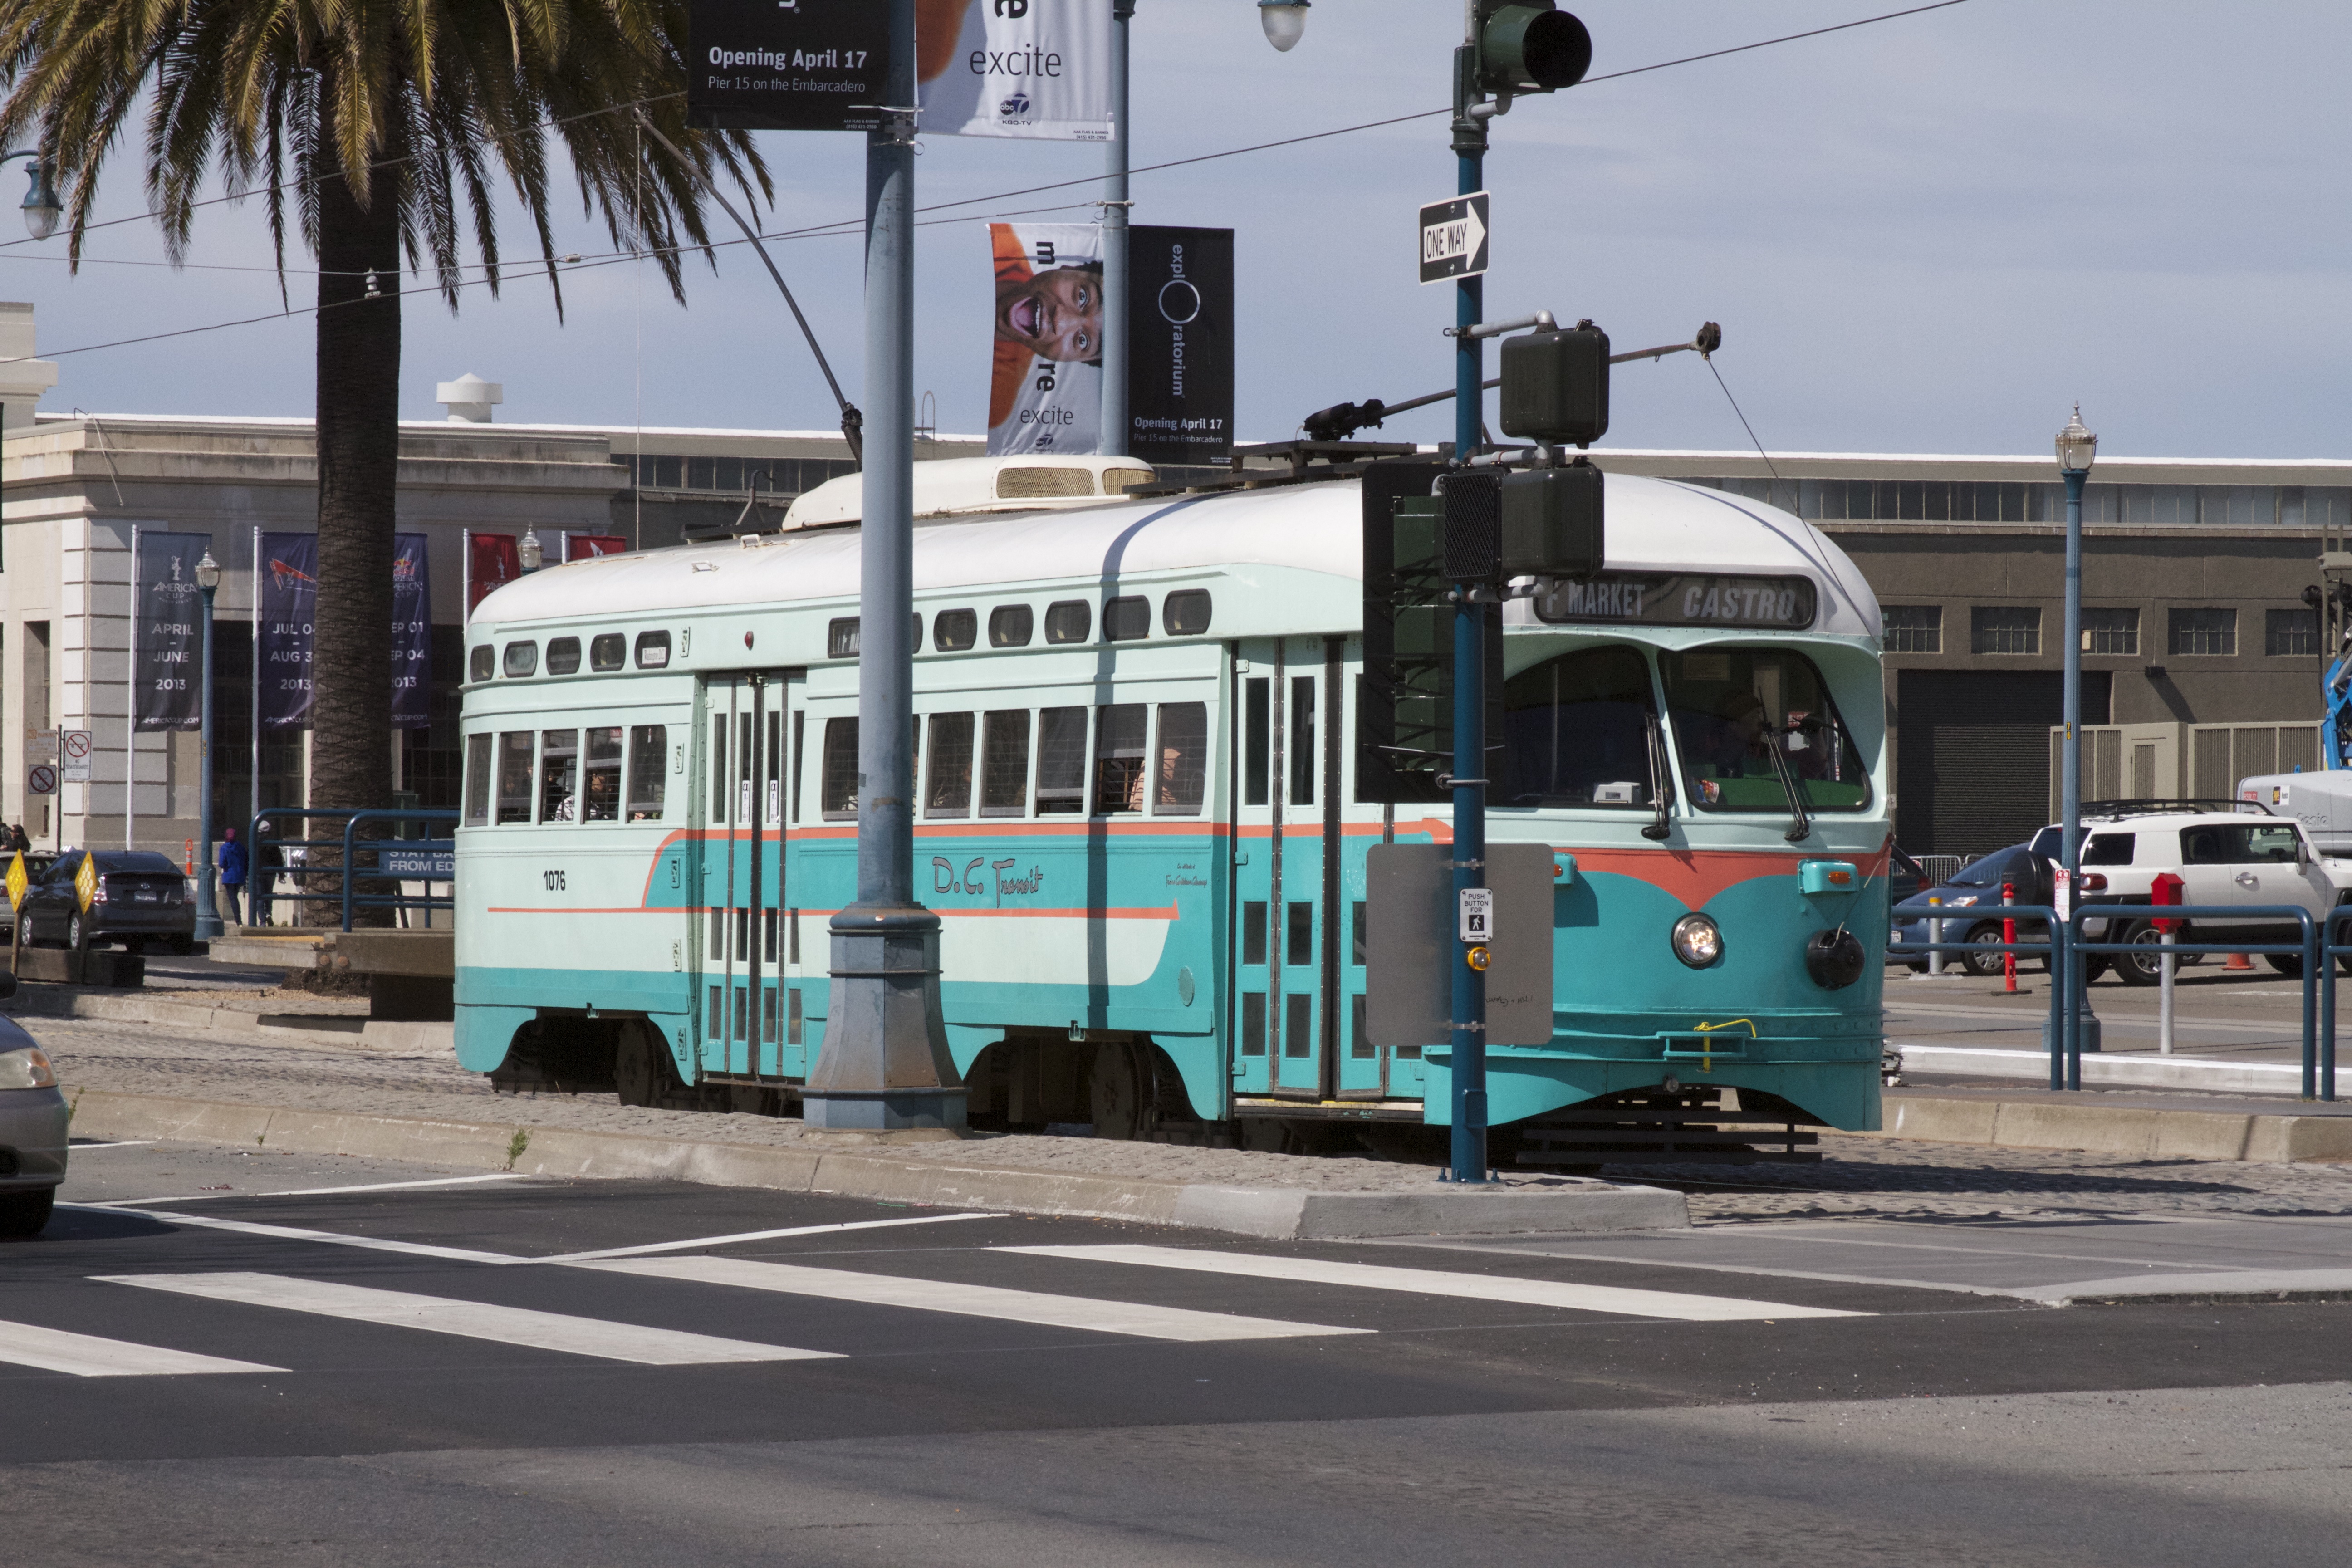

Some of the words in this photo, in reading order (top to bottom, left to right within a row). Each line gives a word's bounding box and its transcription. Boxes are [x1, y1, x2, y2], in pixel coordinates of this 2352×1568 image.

[709, 47, 786, 71] Opening
[792, 49, 837, 71] April
[845, 51, 867, 69] 17
[970, 43, 1061, 77] excite
[709, 76, 731, 89] Pier
[735, 77, 750, 89] 15
[754, 80, 767, 90] on
[771, 78, 789, 90] the
[793, 79, 865, 92] Embarcadero
[1000, 103, 1014, 111] abc
[1426, 228, 1444, 259] ONE
[1448, 222, 1467, 254] WAY
[1020, 406, 1073, 426] excite
[1135, 417, 1177, 431] Opening
[1181, 418, 1206, 431] April
[1210, 419, 1223, 430] 17
[1134, 433, 1147, 441] Pier
[1181, 435, 1223, 443] Embarcadero
[1568, 582, 1645, 616] MARKET
[1683, 586, 1796, 621] CASTRO
[152, 624, 194, 635] APRIL
[272, 623, 298, 635] JUL
[302, 623, 315, 635] 0
[392, 622, 405, 633] EP
[409, 622, 423, 633] 01
[153, 652, 189, 662] JUNE
[270, 651, 300, 662] AUG
[305, 651, 313, 662] 3
[407, 649, 425, 660] 04
[155, 679, 186, 690] 2013
[280, 679, 312, 690] 2013
[389, 861, 431, 871] FROM
[436, 862, 455, 871] ED
[544, 870, 565, 891] 1076
[992, 858, 1043, 909] Transit
